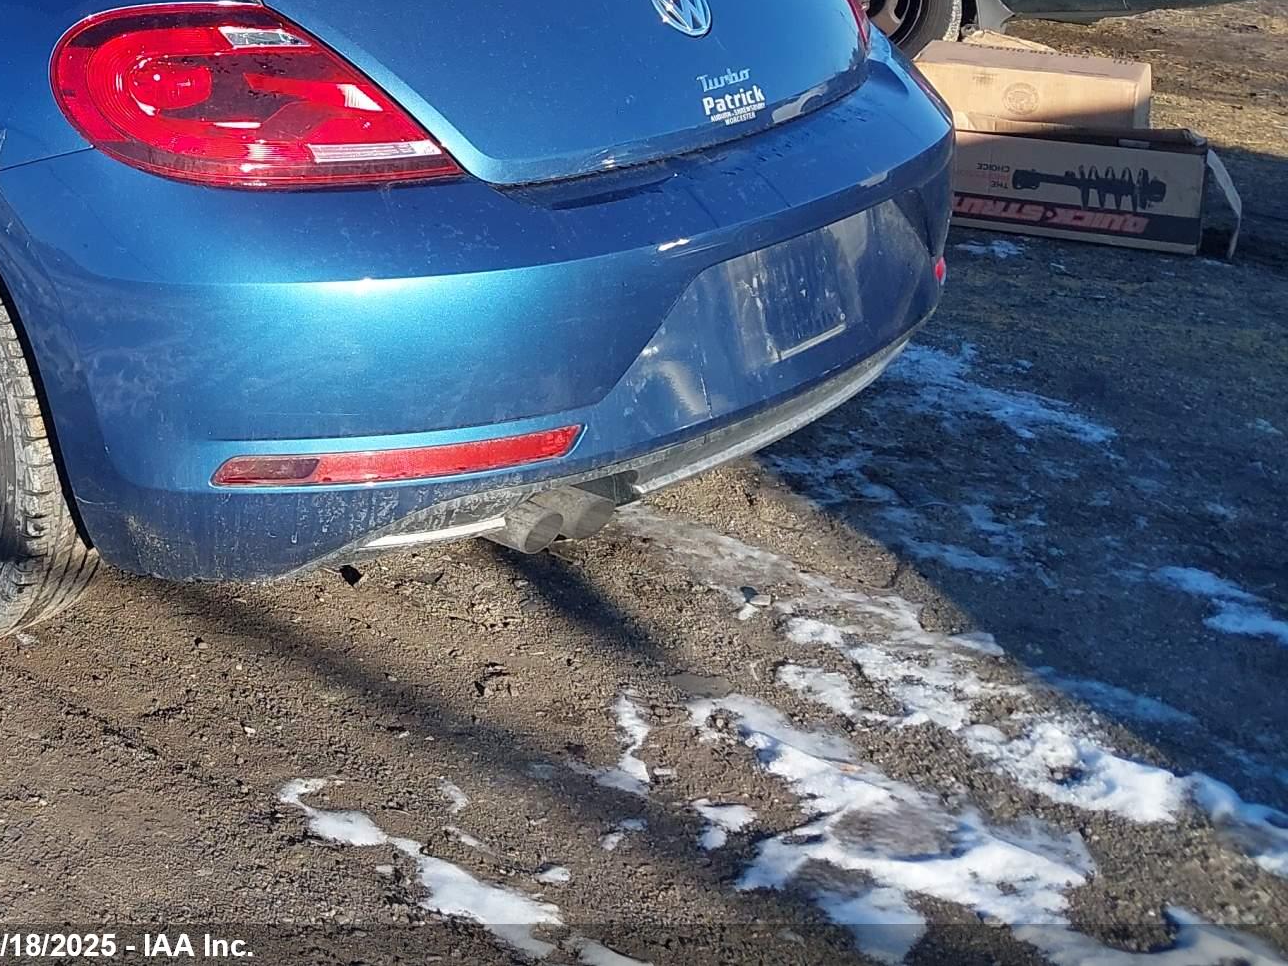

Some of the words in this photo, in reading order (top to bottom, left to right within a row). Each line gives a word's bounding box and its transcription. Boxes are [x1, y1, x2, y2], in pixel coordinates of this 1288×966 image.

[696, 67, 751, 92] Turbo
[702, 84, 766, 116] Patrick
[976, 162, 1010, 174] CHOICE
